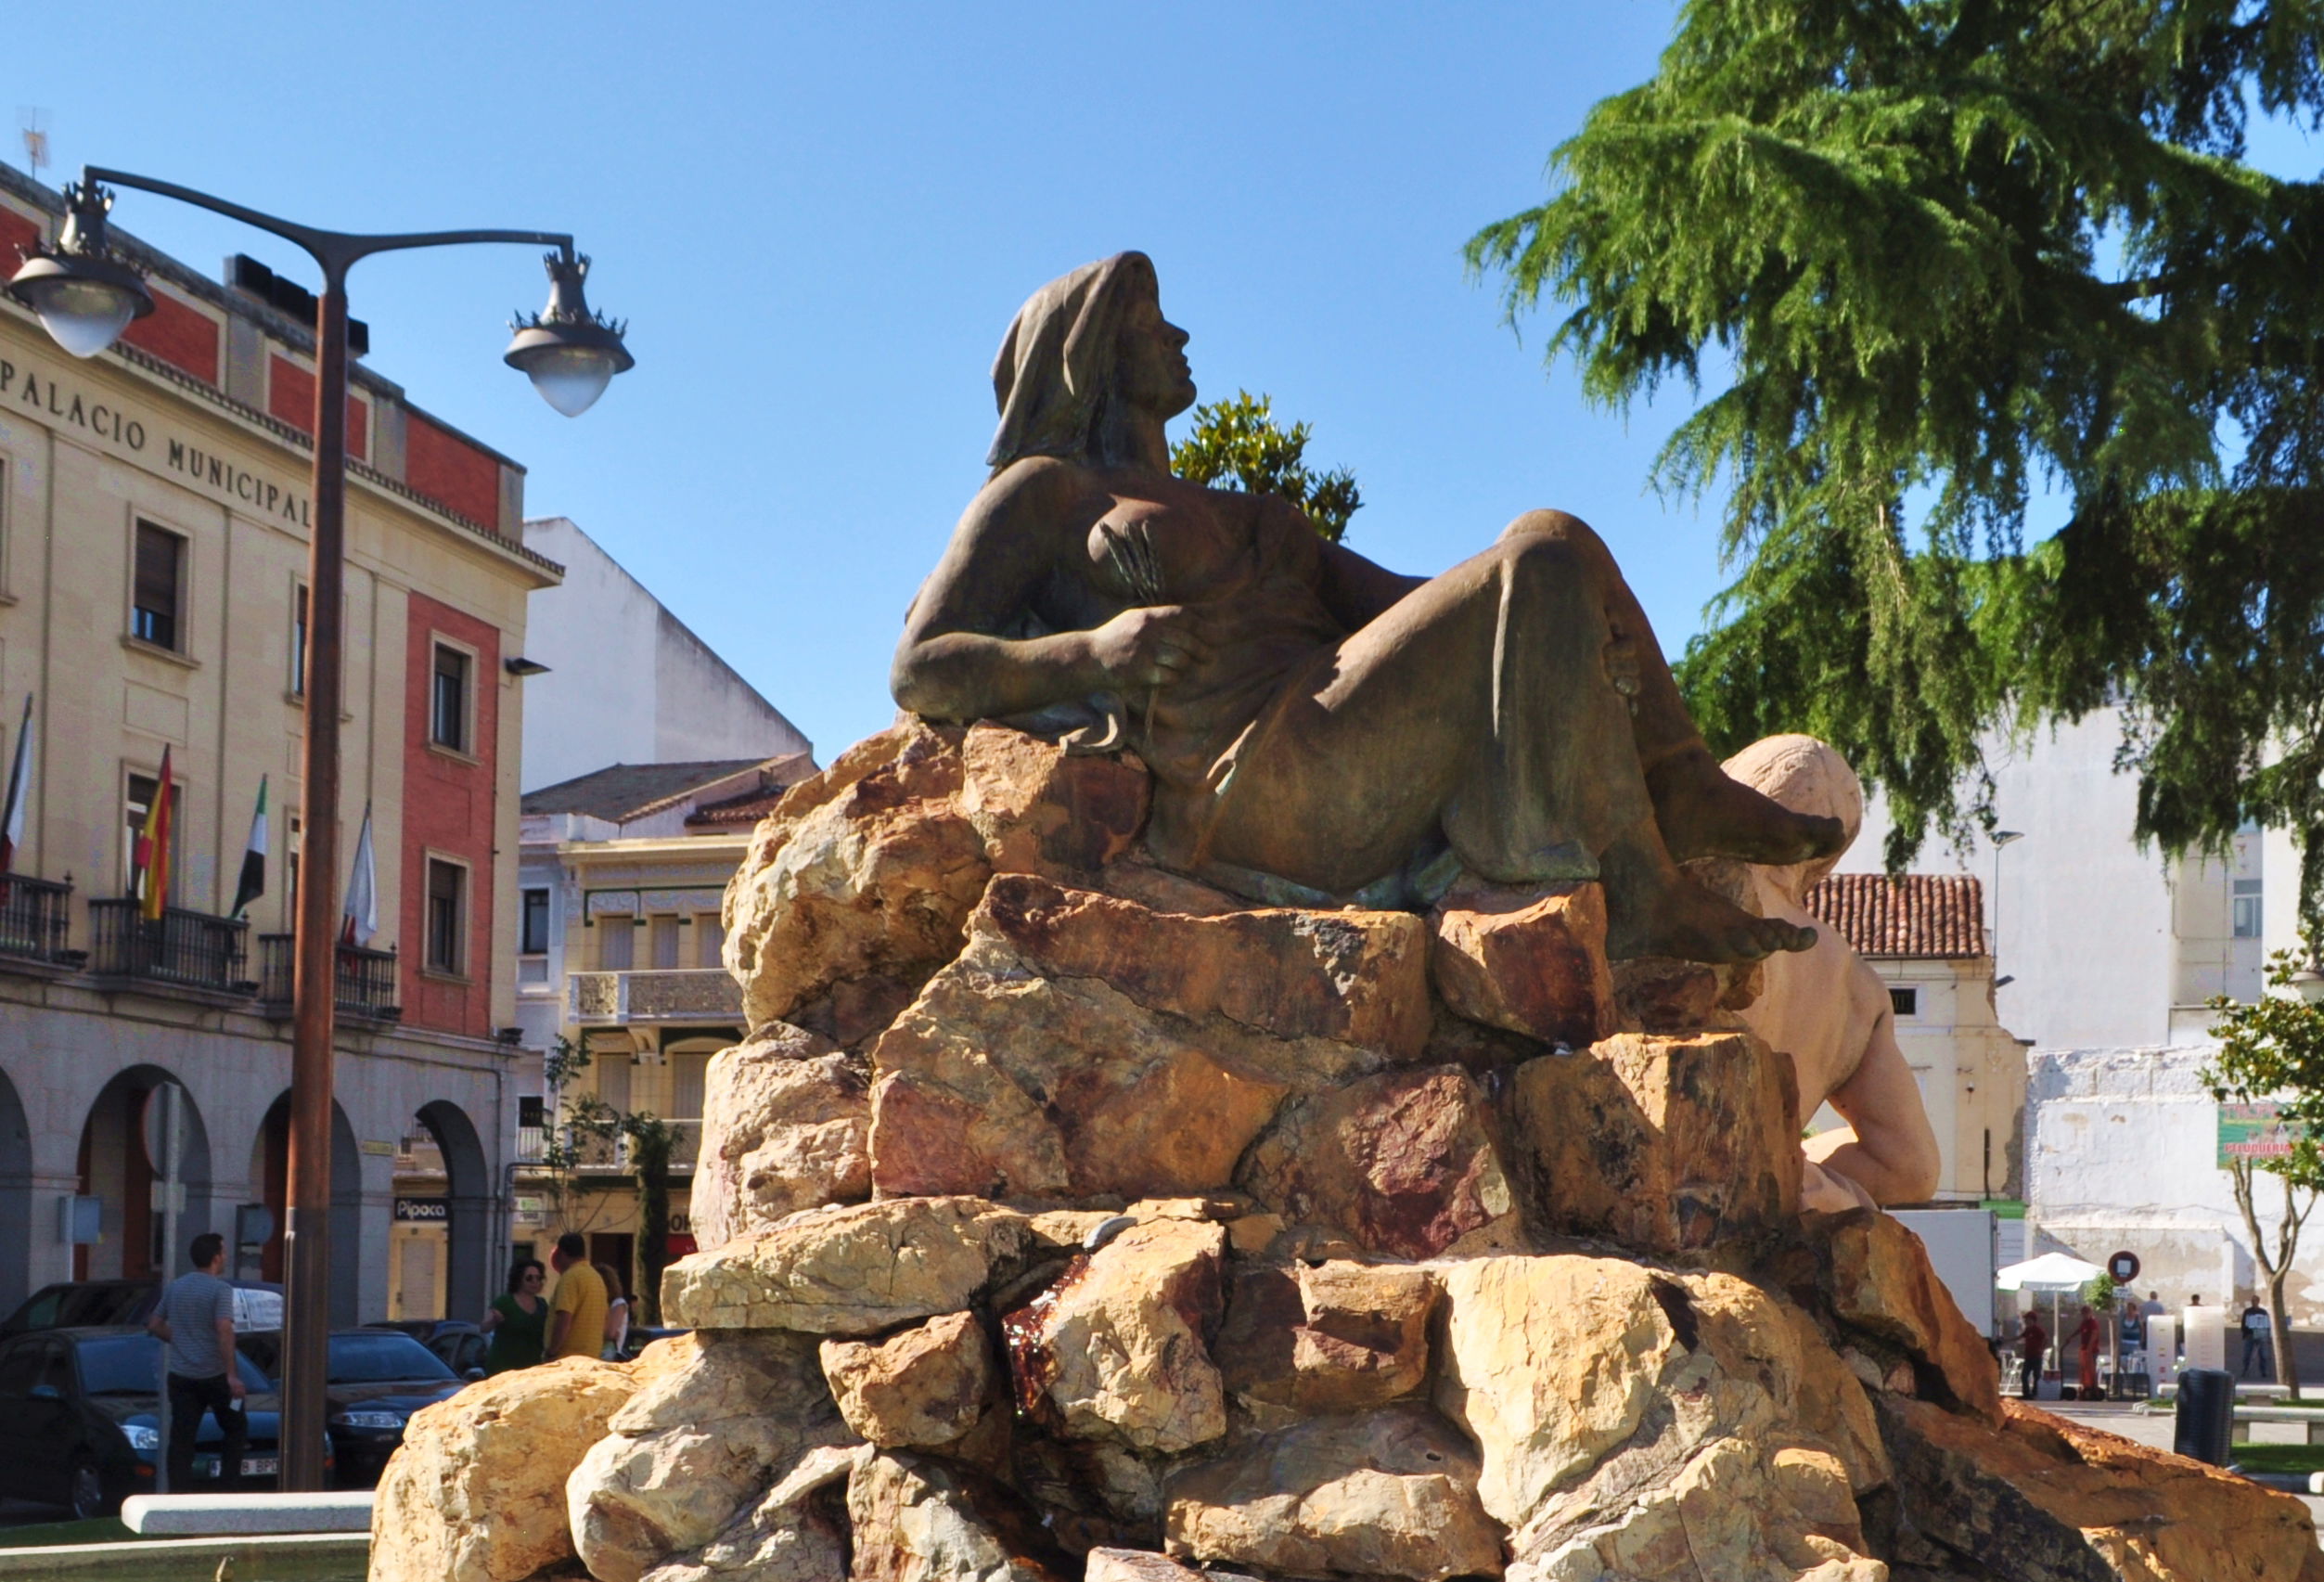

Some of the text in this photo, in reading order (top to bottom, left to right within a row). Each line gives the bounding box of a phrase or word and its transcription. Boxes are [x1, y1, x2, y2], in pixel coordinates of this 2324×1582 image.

[0, 359, 312, 529] PALACIO MUNICIPAL
[397, 1201, 445, 1220] Pipoca
